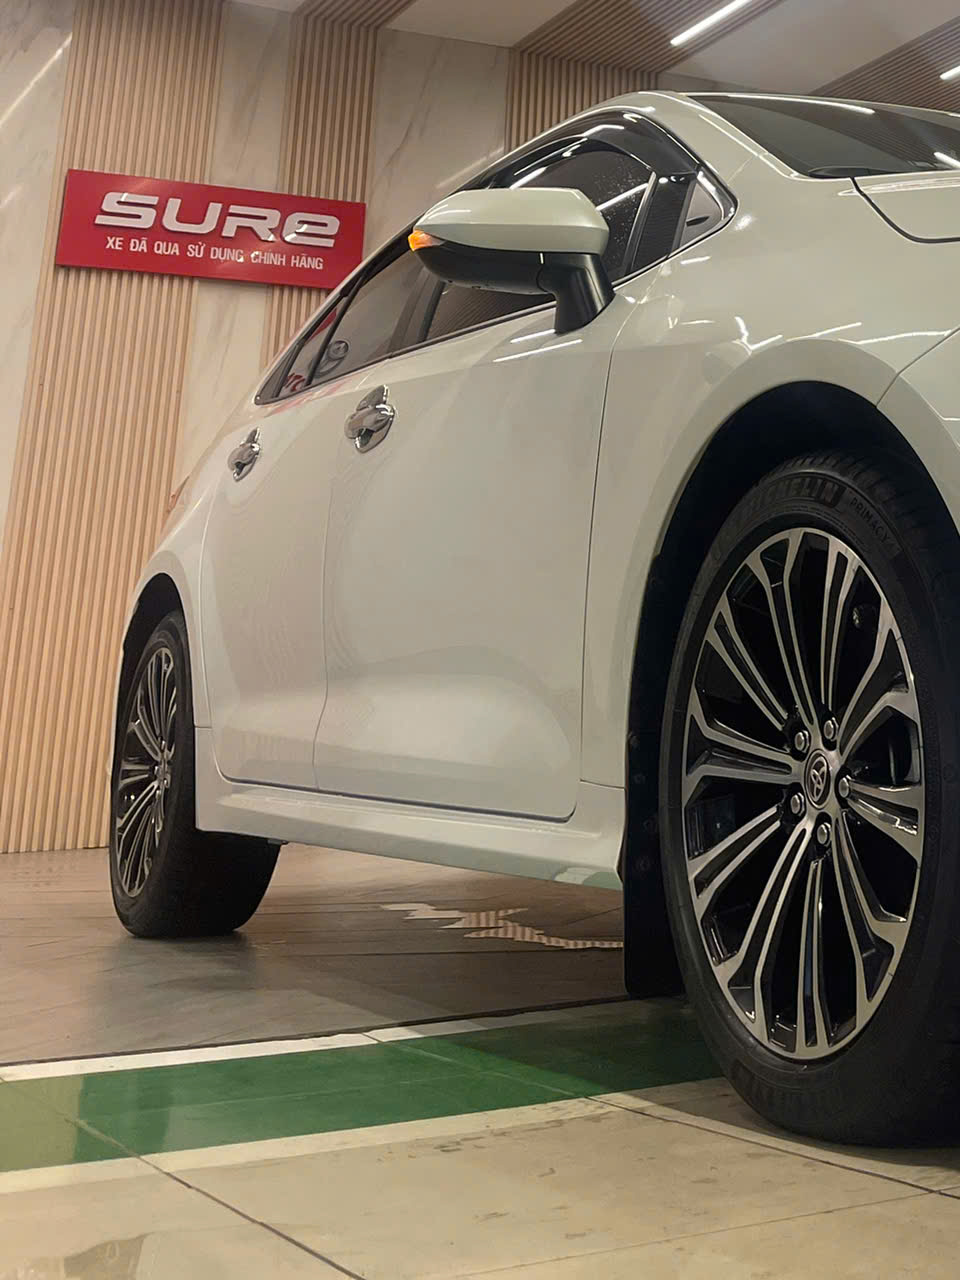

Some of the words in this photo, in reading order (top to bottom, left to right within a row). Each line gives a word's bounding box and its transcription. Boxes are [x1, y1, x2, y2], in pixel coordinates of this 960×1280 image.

[105, 236, 123, 250] XE
[129, 237, 148, 253] ĐÃ
[153, 240, 180, 256] QUA
[187, 241, 206, 258] SỬ
[210, 247, 245, 263] DỤNG
[250, 249, 286, 266] CHÍNH
[291, 253, 324, 270] HÃNG
[849, 497, 890, 544] PRIMACY
